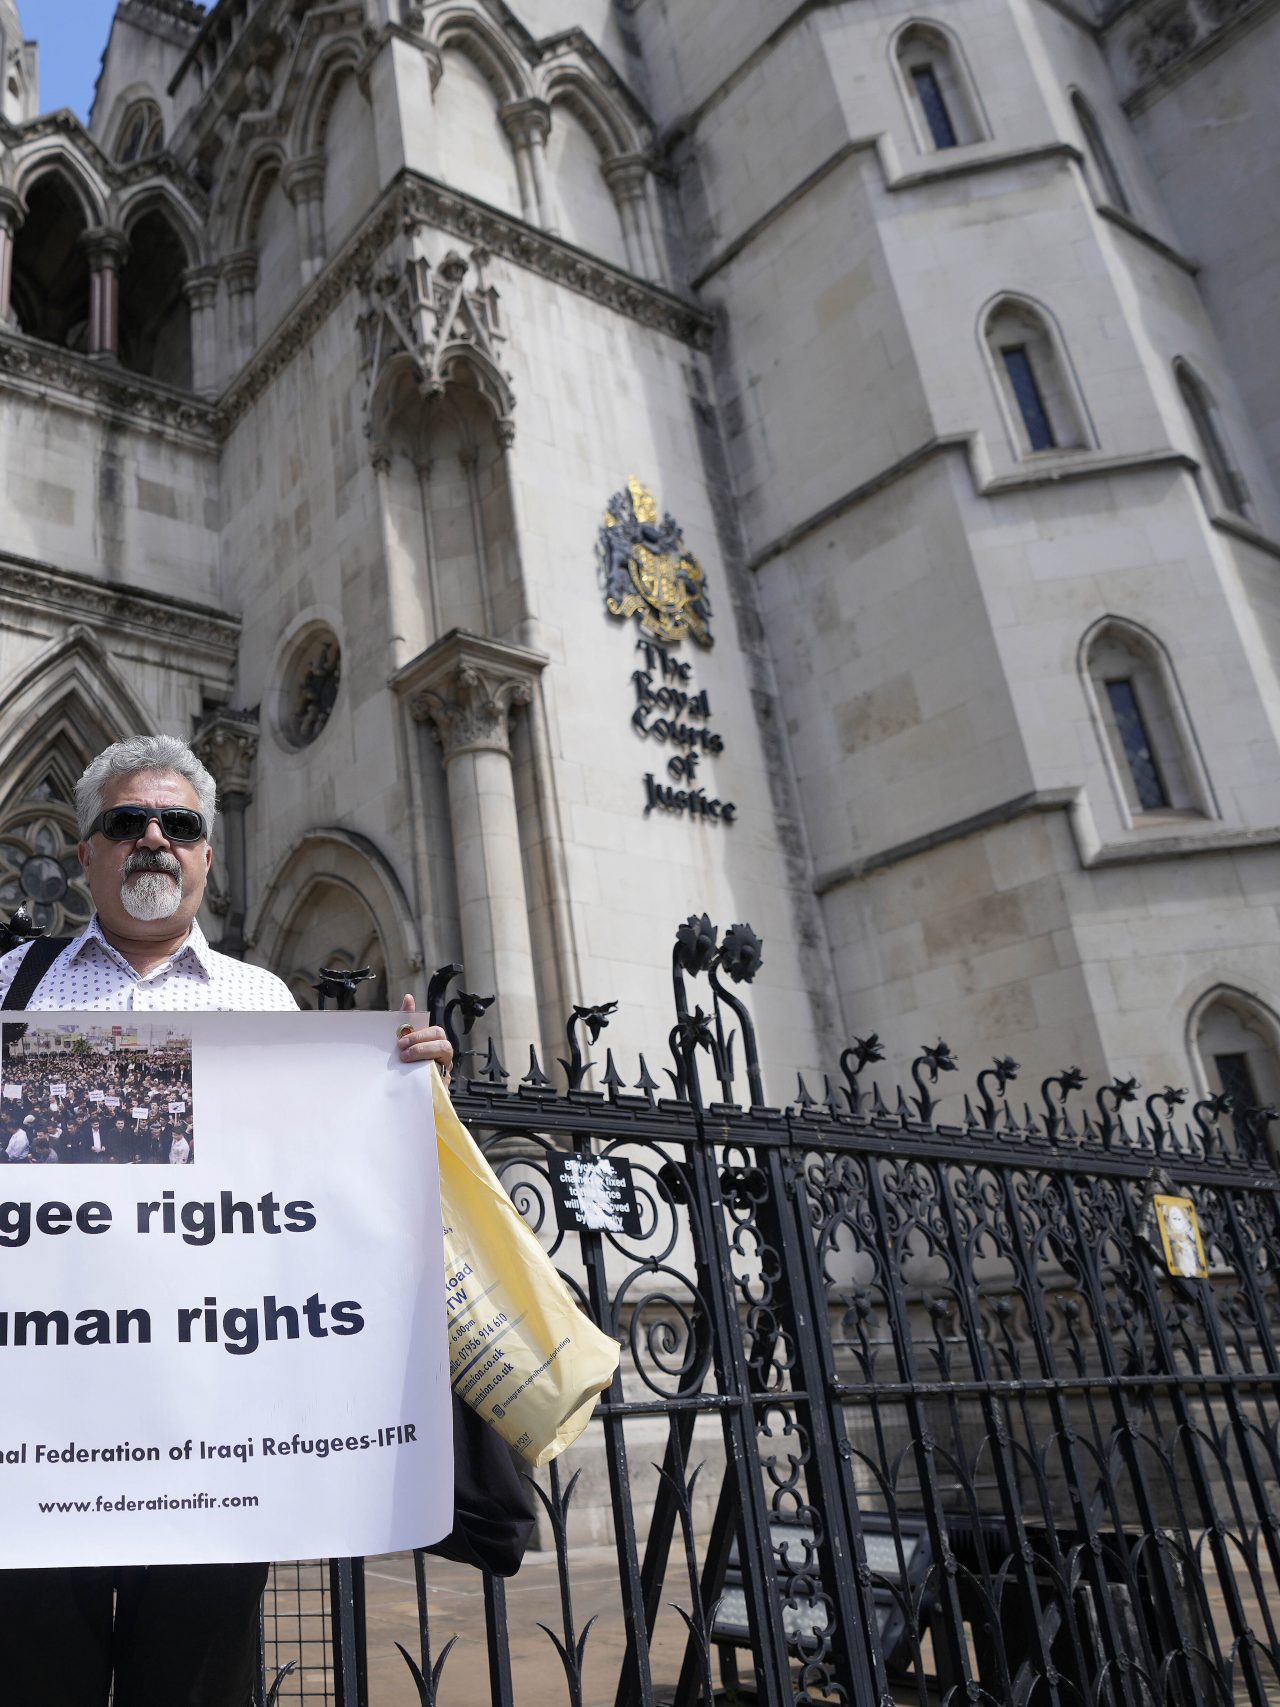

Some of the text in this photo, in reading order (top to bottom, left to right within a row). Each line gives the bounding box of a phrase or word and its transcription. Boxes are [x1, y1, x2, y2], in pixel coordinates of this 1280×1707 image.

[635, 639, 692, 682] The
[631, 670, 711, 718] Royal
[632, 705, 723, 753] Courts
[668, 752, 699, 780] of
[642, 773, 736, 822] Justice
[564, 1199, 580, 1209] will
[605, 1177, 626, 1187] fixed
[136, 1191, 317, 1247] rights
[177, 1292, 365, 1356] rights
[458, 1336, 481, 1360] 07956
[478, 1324, 495, 1340] 914
[492, 1313, 508, 1328] 610
[35, 1441, 160, 1464] Federation
[168, 1440, 193, 1461] of
[200, 1437, 254, 1463] Iraqi
[262, 1423, 418, 1458] Refugees-IFIR
[38, 1492, 260, 1514] www.federationifir.com
